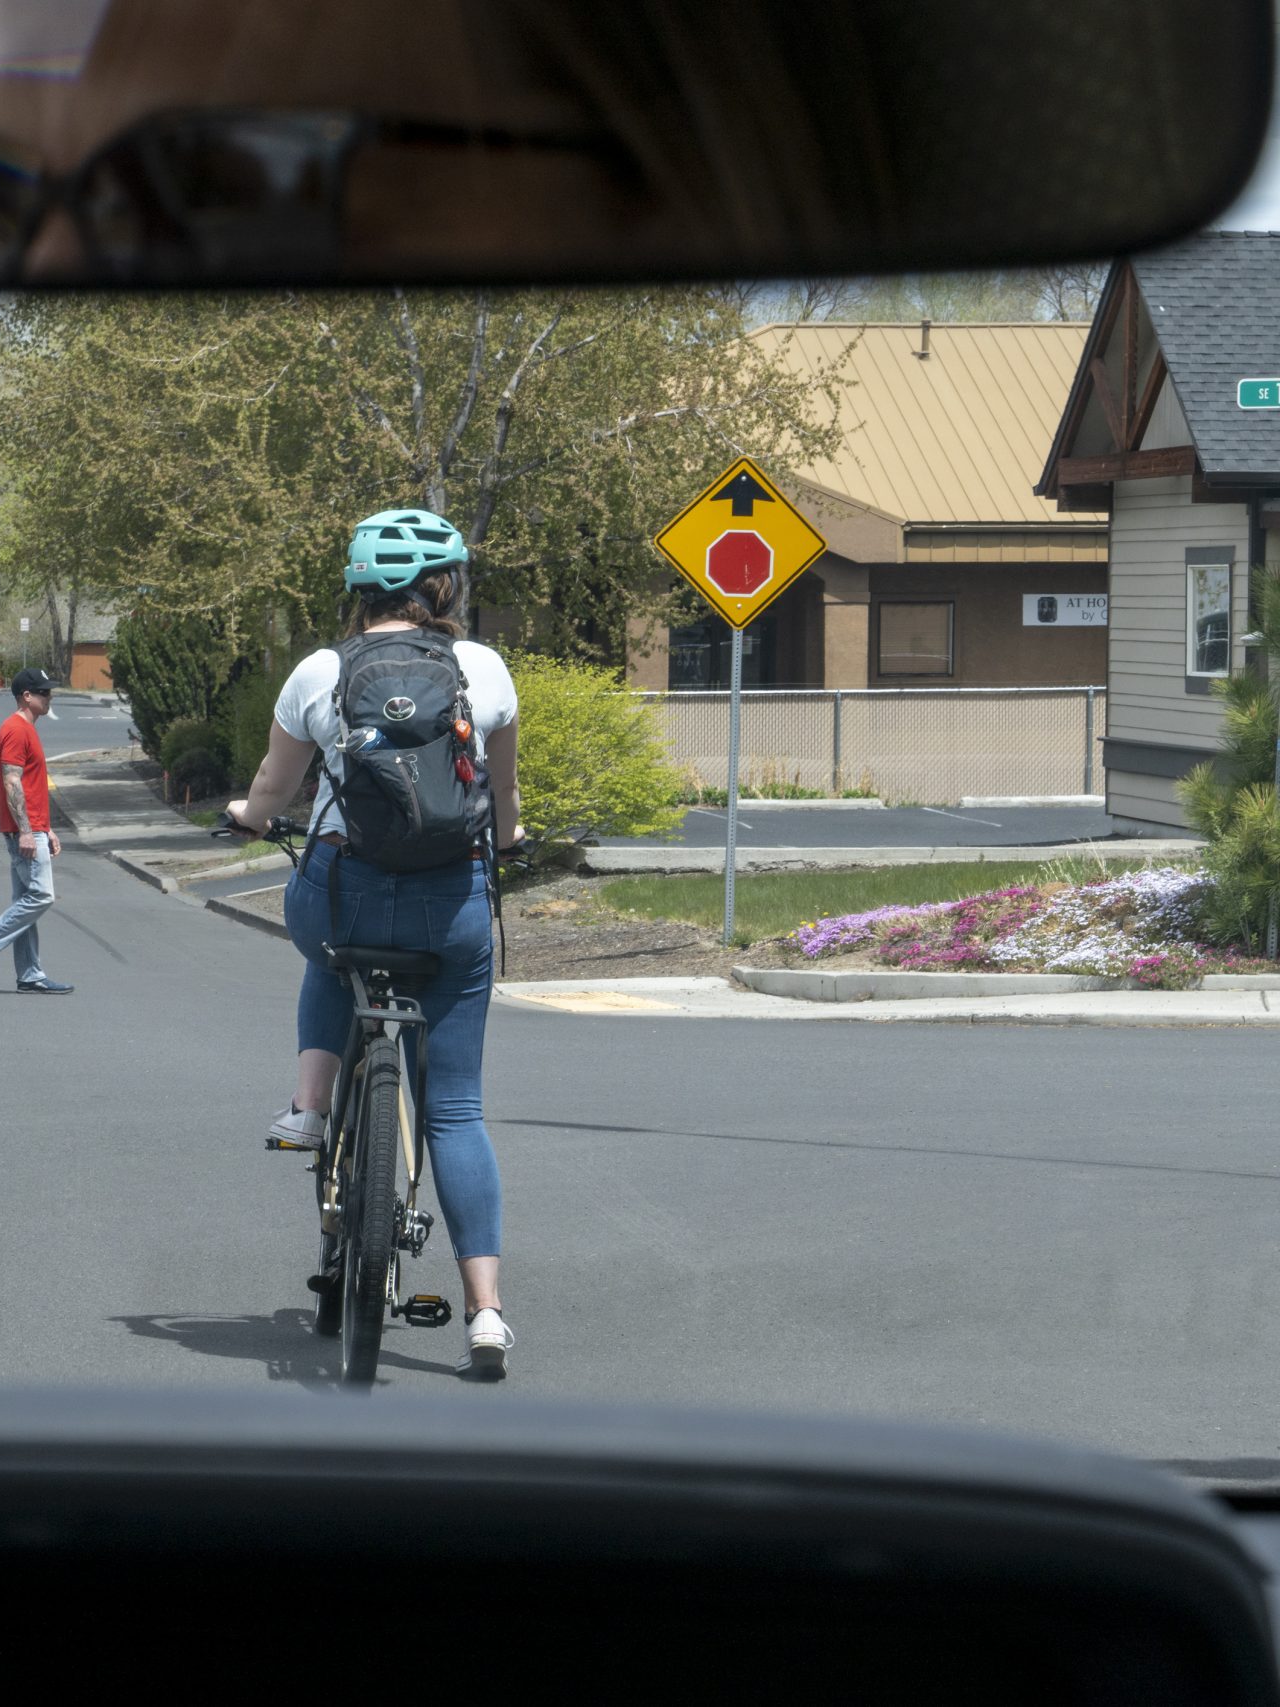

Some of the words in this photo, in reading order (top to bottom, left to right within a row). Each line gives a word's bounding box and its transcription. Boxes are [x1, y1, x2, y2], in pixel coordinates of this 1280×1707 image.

[1258, 388, 1269, 400] SE
[1066, 597, 1083, 608] AT
[1081, 610, 1095, 622] by
